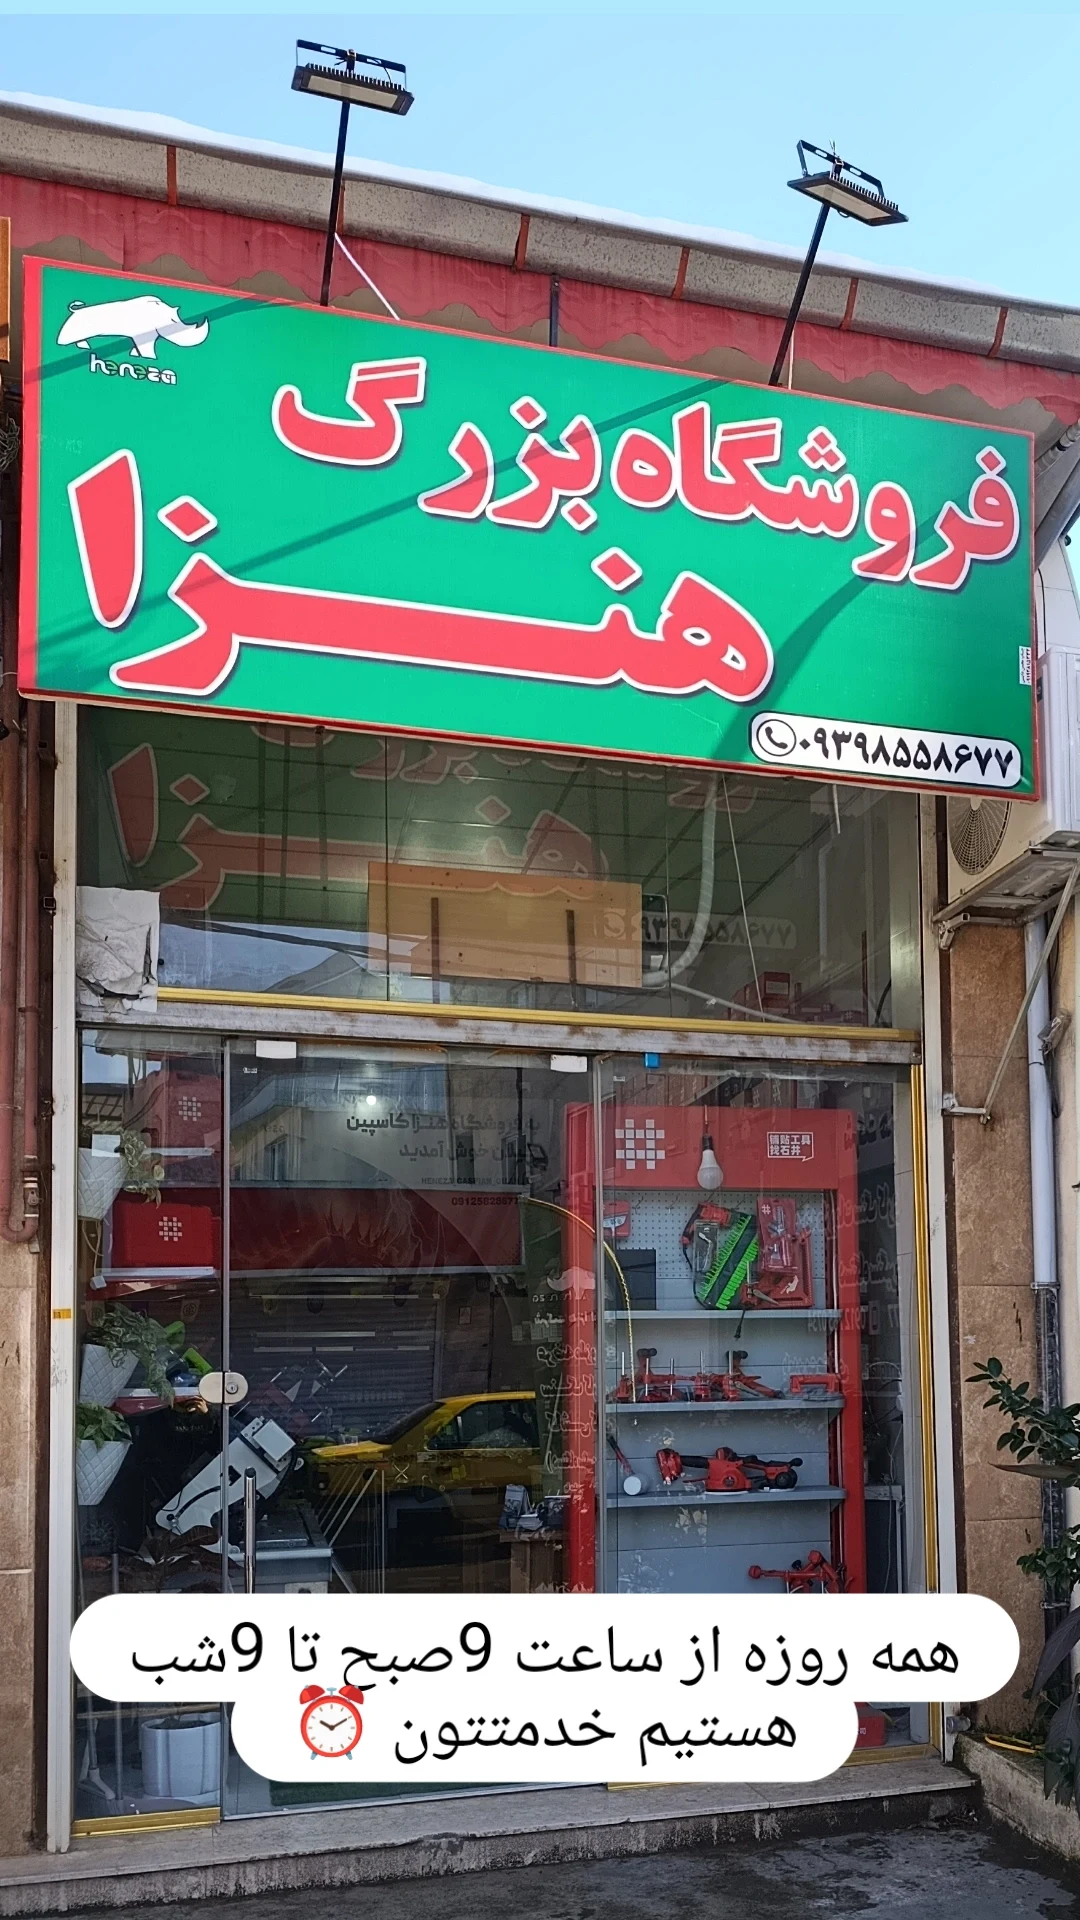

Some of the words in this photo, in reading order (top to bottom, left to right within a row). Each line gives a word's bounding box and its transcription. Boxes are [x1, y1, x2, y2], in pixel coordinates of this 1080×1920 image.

[89, 352, 177, 385] heneza
[271, 355, 603, 531] بزرگ
[610, 401, 1020, 590] فروشگاه
[66, 447, 775, 702] هنزا
[799, 726, 1014, 779] ۰۹۳۹۸۵۵۸۶۷۷
[346, 1112, 410, 1137] کاسپین
[769, 1144, 801, 1157] 找石井
